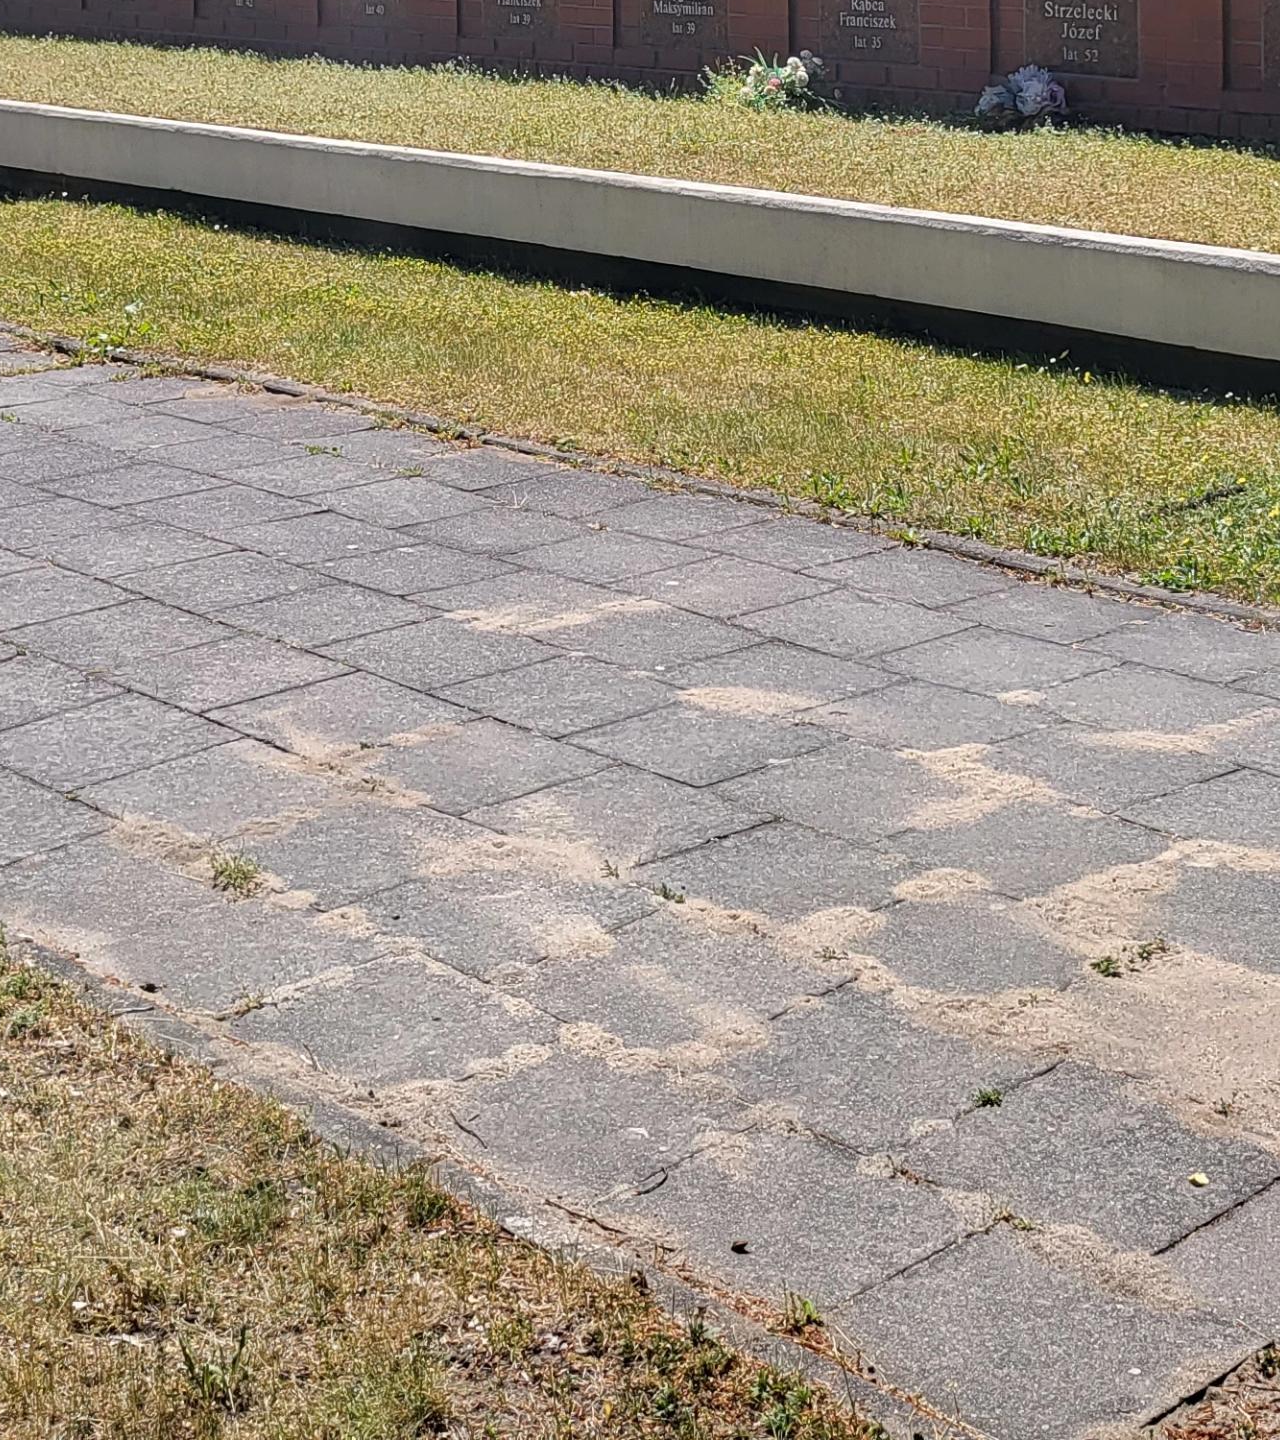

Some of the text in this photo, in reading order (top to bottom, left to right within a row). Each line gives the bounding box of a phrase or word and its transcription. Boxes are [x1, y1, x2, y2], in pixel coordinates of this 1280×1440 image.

[653, 0, 714, 16] Maksymilian
[1044, 0, 1118, 21] Strzelecki
[510, 12, 531, 25] lat 39
[840, 12, 897, 29] Franciszek
[672, 22, 696, 34] lat 39
[1061, 22, 1103, 40] Józef
[854, 36, 882, 49] lat 35
[1063, 46, 1099, 62] lat 52
